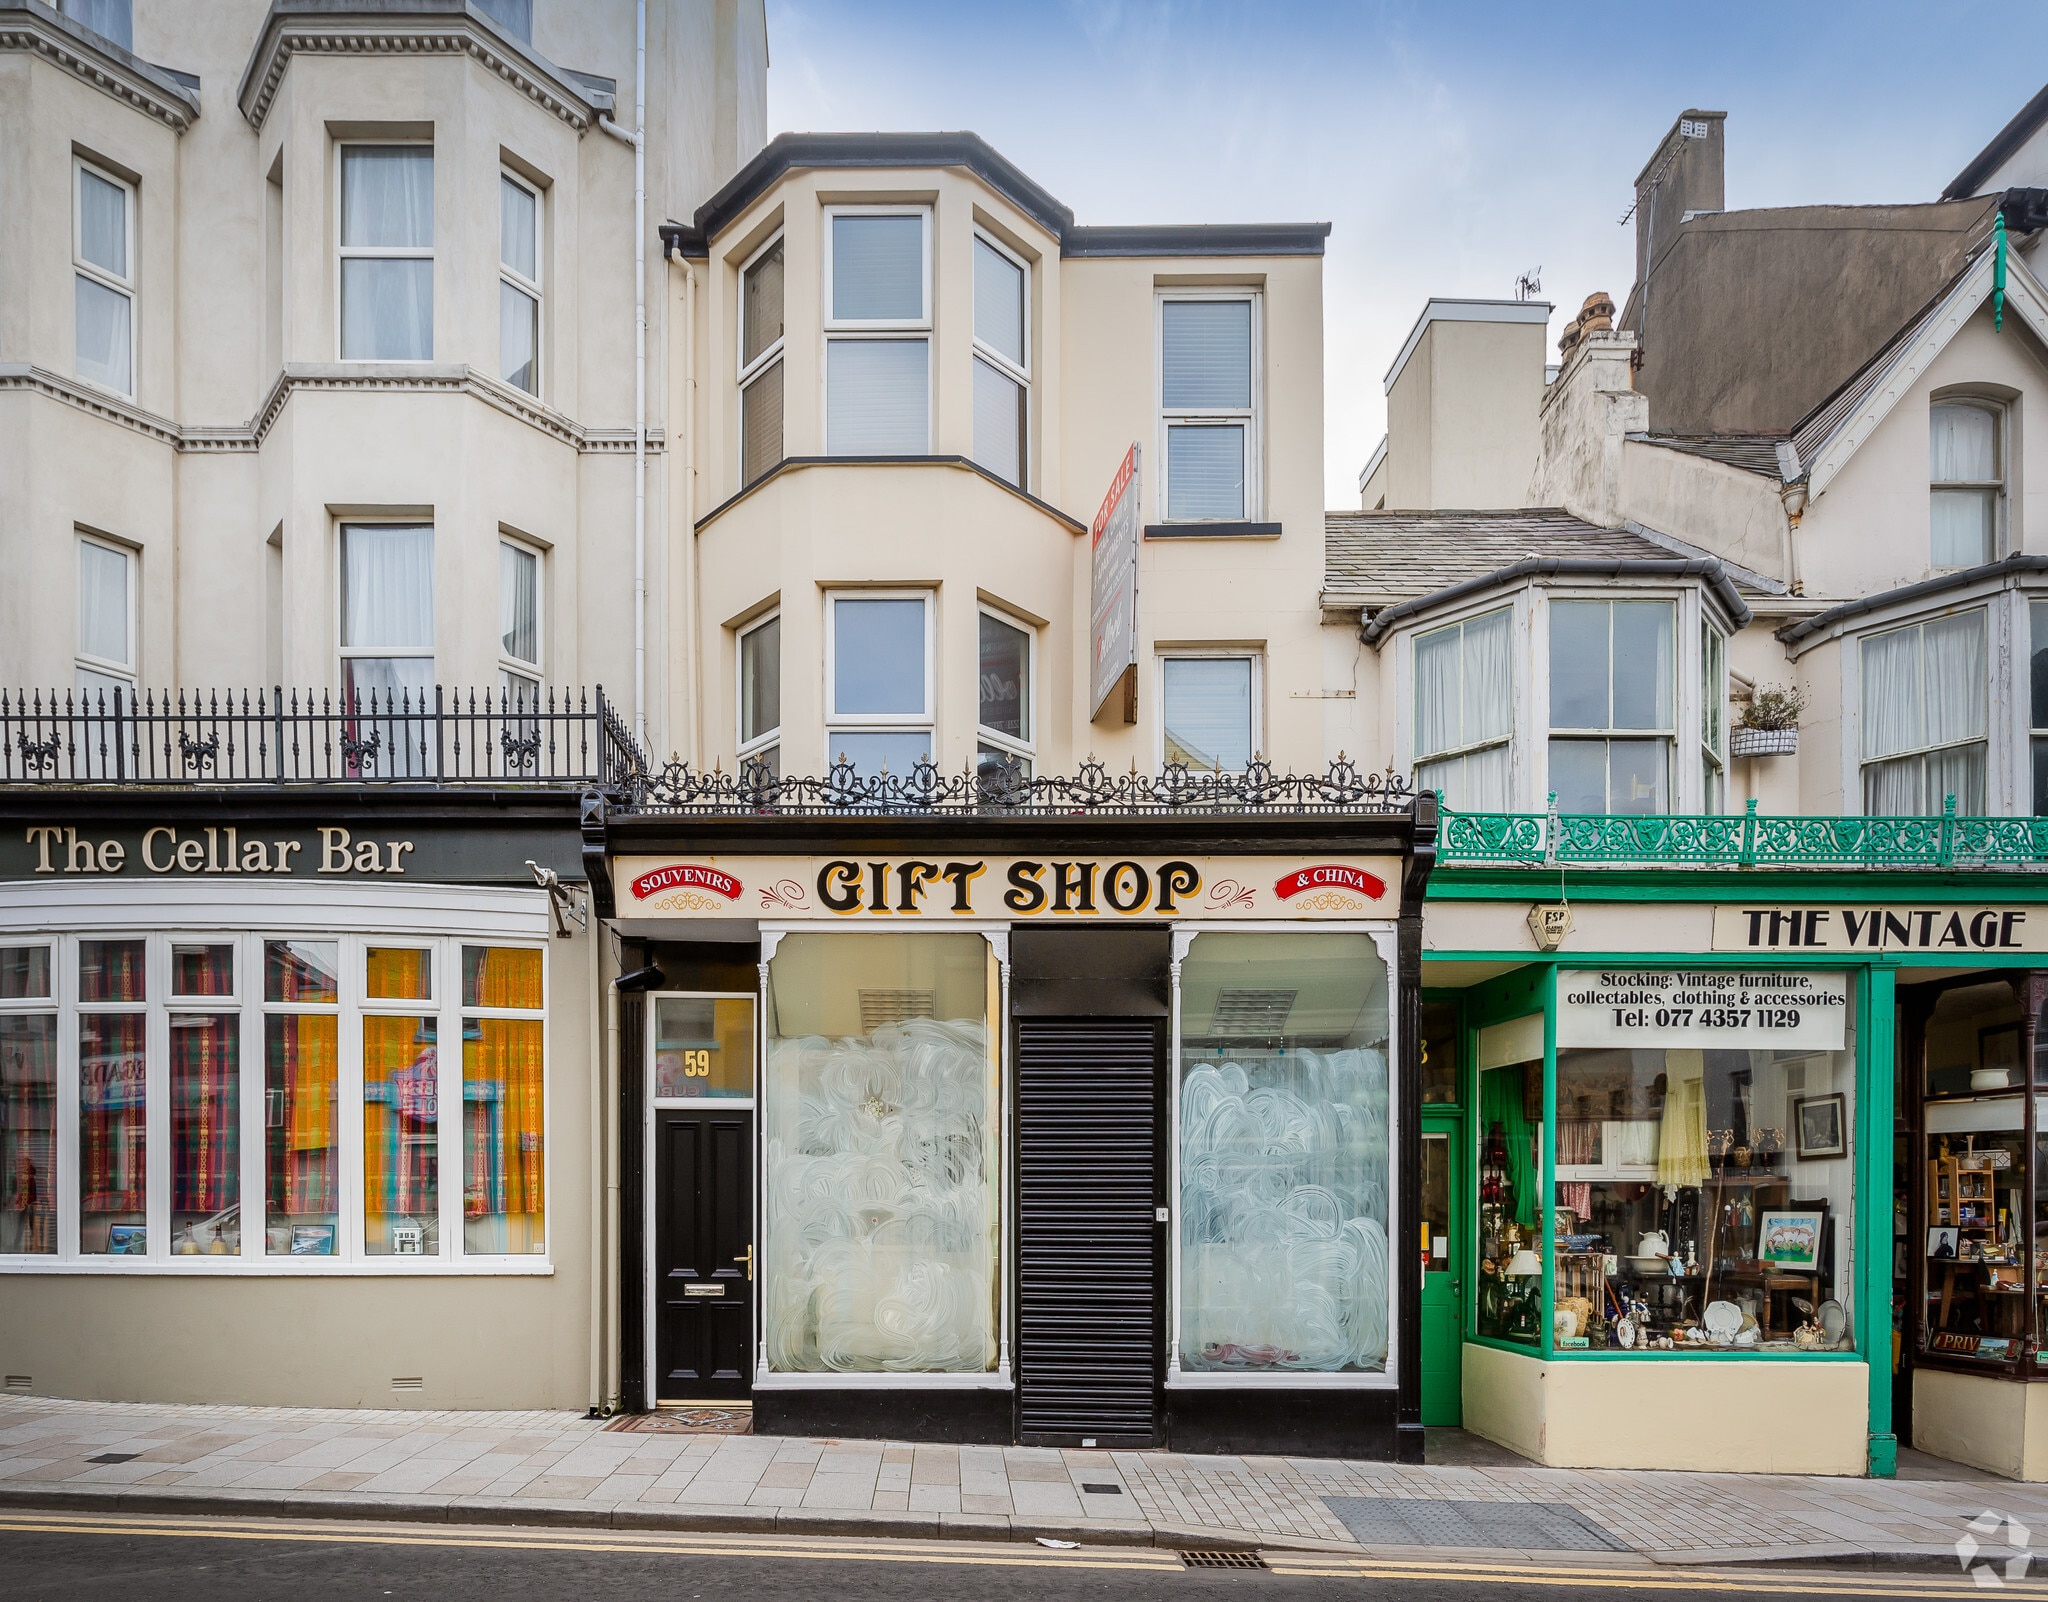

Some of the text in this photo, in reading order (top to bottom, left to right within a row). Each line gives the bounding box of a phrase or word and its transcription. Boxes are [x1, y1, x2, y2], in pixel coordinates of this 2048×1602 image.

[1094, 454, 1131, 542] FOR SALE
[26, 827, 414, 873] The Cellar Bar
[640, 868, 733, 893] SOUVENIRS
[817, 860, 1203, 915] GIFT SHOP
[1296, 869, 1364, 888] & CHINA
[1545, 911, 1565, 925] FSP
[1742, 910, 2027, 948] THE VINTAGE
[1600, 972, 1813, 990] Stocking: Vintage furniture,
[1567, 991, 1846, 1007] collectables, clothing & accessories
[1612, 1008, 1802, 1028] Tel: 077 4357 1129
[684, 1049, 710, 1077] 59
